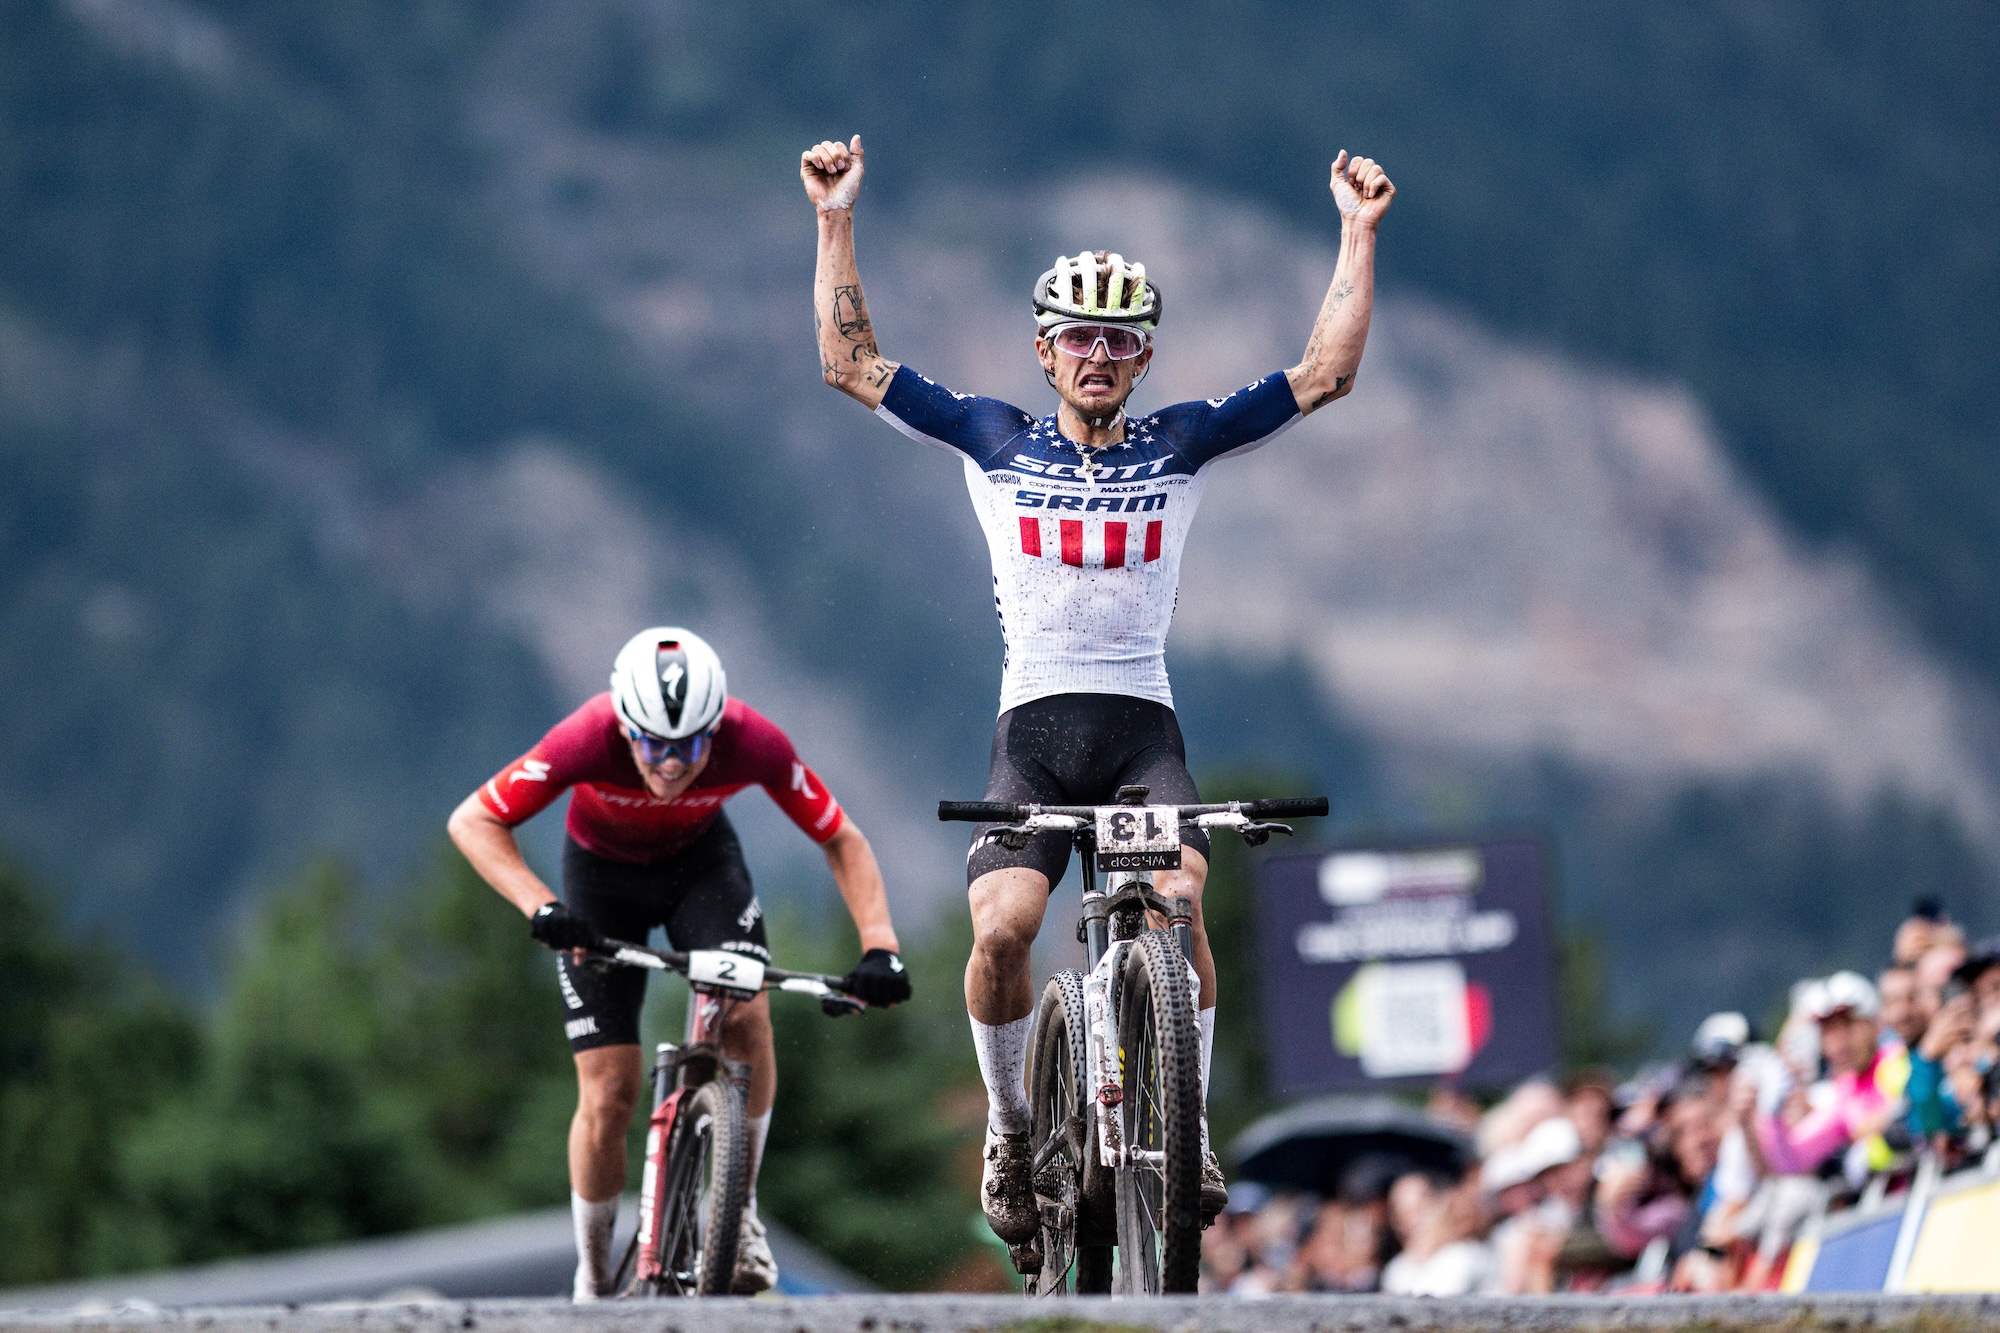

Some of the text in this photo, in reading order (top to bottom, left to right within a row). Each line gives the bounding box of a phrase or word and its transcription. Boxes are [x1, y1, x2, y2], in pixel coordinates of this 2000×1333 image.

[1009, 453, 1174, 481] SCOTT
[1100, 484, 1147, 493] MAXXIS
[1015, 489, 1168, 513] SRAM
[1110, 811, 1163, 841] 13
[717, 960, 737, 981] 2
